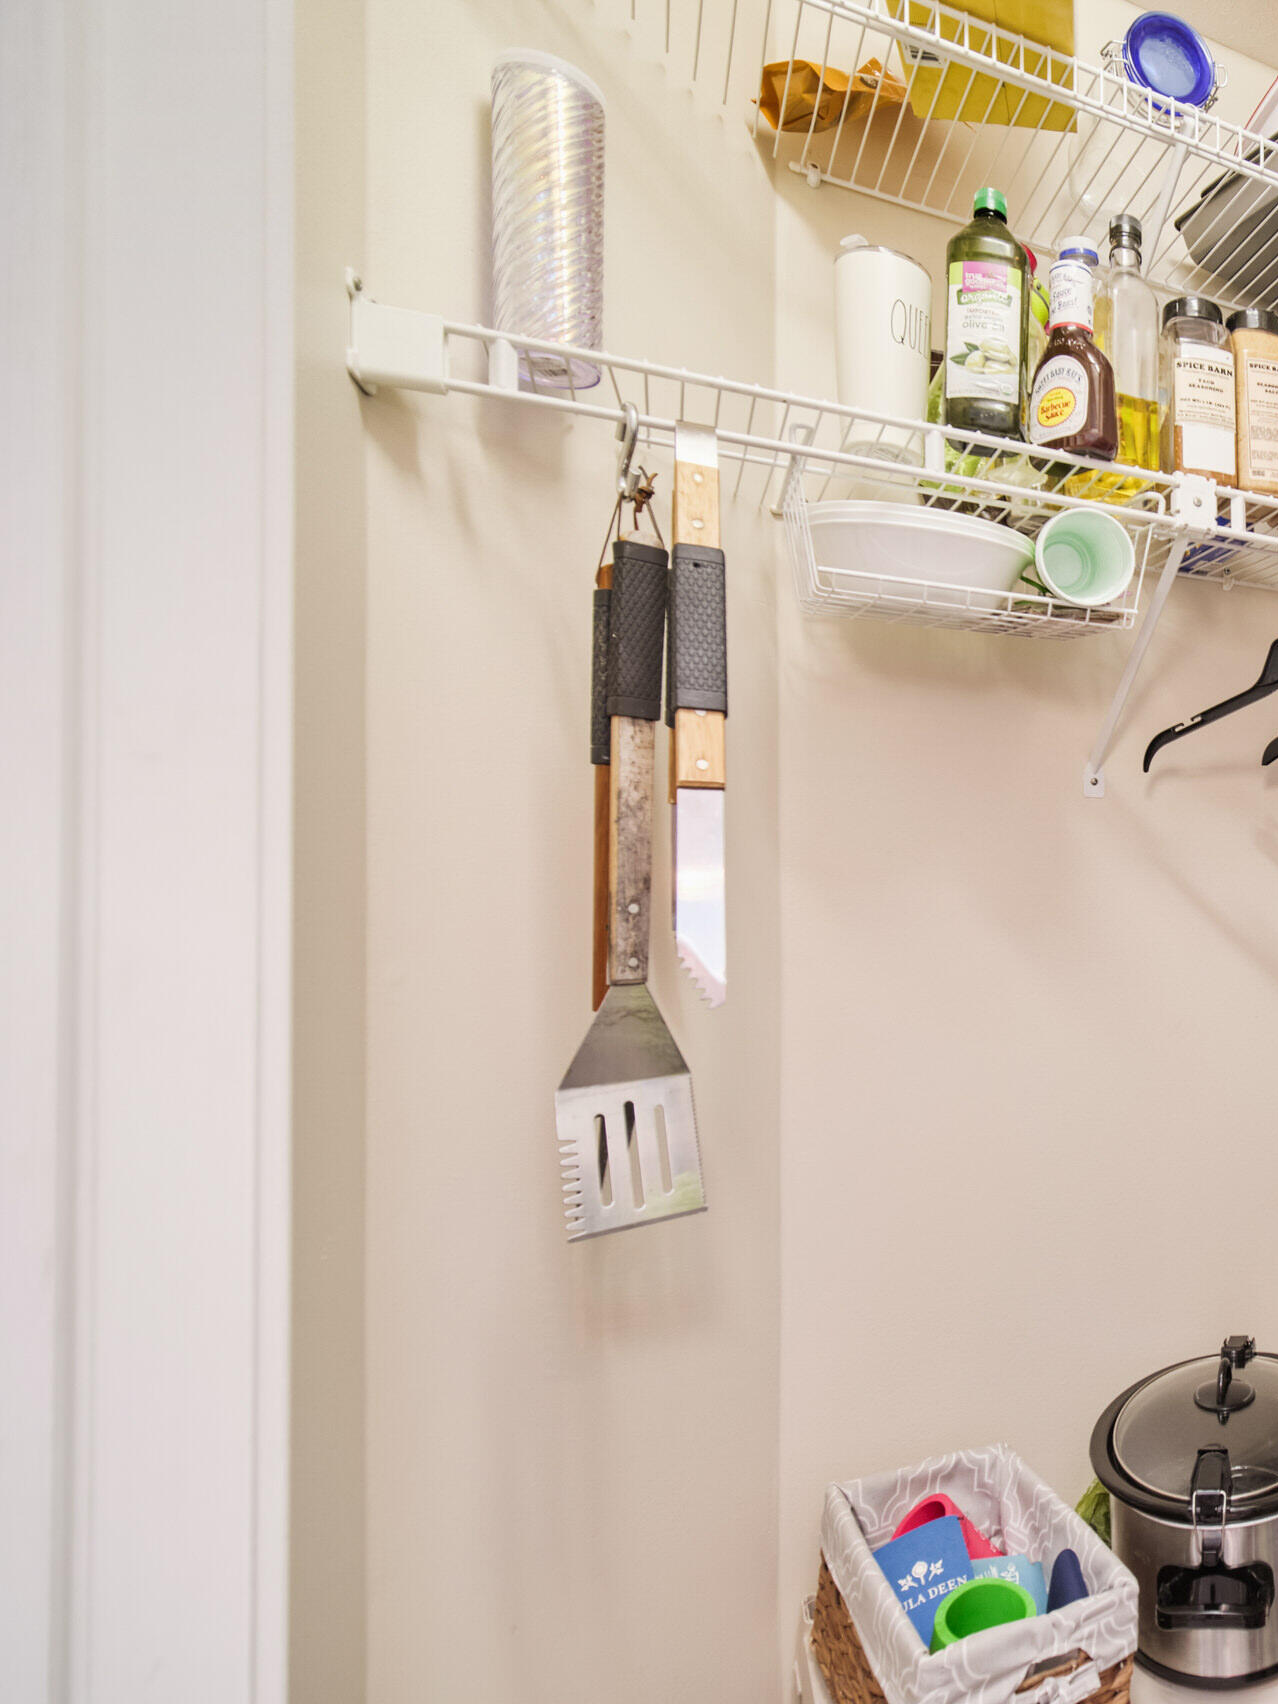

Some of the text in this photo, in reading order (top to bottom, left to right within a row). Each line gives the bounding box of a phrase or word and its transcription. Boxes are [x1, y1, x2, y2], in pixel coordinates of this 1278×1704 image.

[962, 320, 988, 330] olive
[1176, 361, 1233, 377] SPICE BARN
[1249, 363, 1272, 372] SPICE
[1040, 400, 1072, 415] Barbecue
[902, 1575, 967, 1612] ULA DEEN
